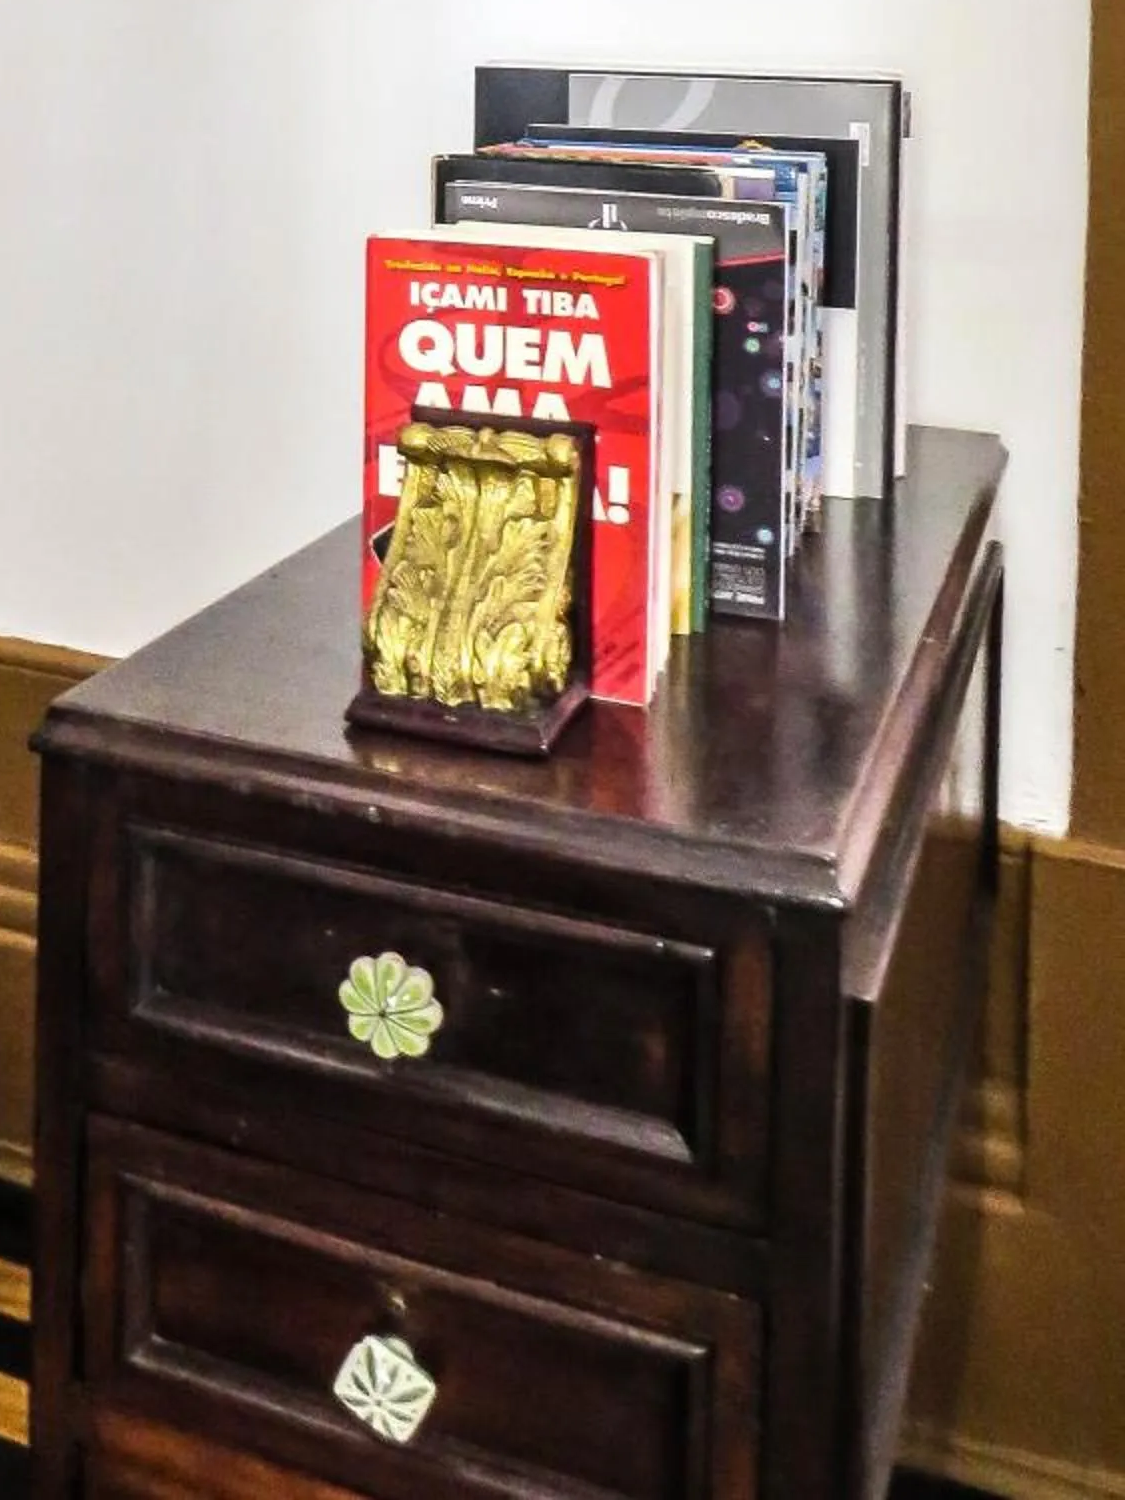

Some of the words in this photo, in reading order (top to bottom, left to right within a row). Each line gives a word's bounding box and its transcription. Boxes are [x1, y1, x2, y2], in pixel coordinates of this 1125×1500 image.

[410, 280, 508, 314] IÇAMI
[522, 288, 600, 321] TIBA
[398, 318, 613, 389] QUEM
